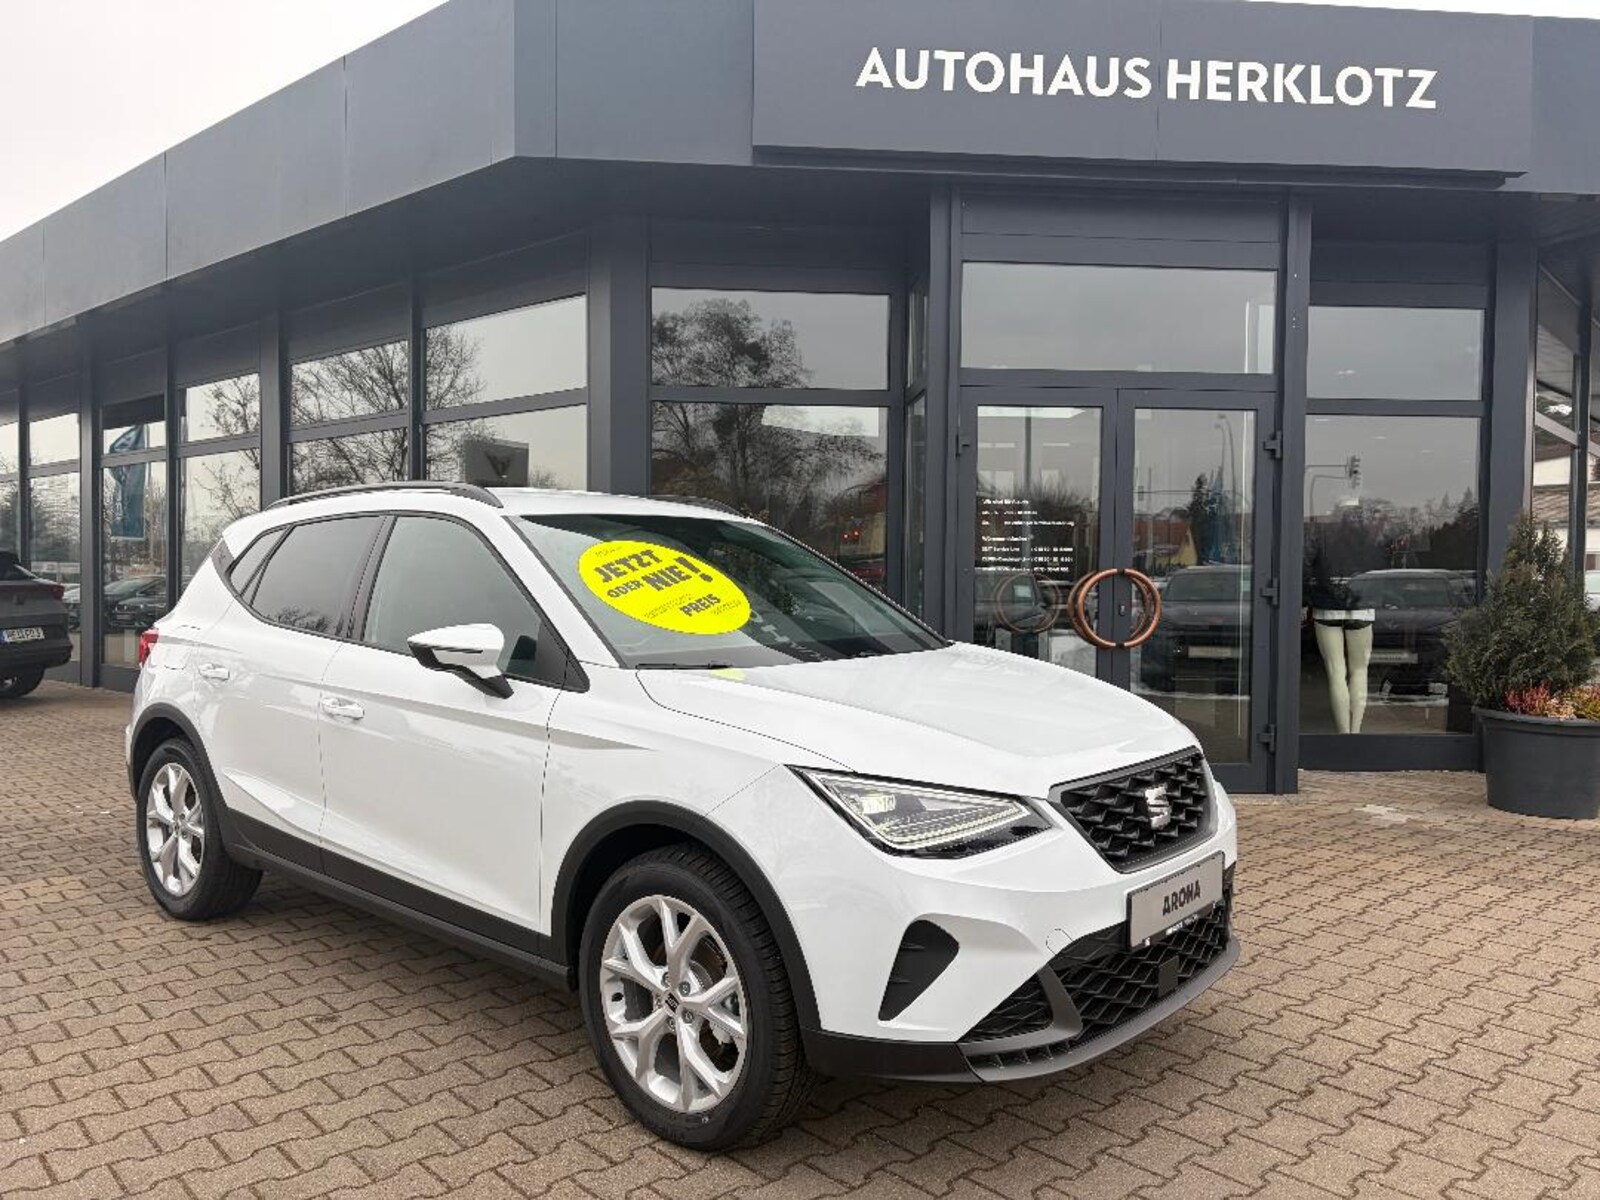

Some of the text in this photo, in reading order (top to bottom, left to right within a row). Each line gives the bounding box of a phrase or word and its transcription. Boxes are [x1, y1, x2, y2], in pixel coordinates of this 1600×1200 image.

[855, 47, 1437, 109] AUTOHAUS HERKLOTZ
[594, 549, 663, 583] JETZT
[607, 579, 644, 598] ODER
[680, 594, 721, 616] PREIS
[1162, 880, 1201, 916] ARONA
